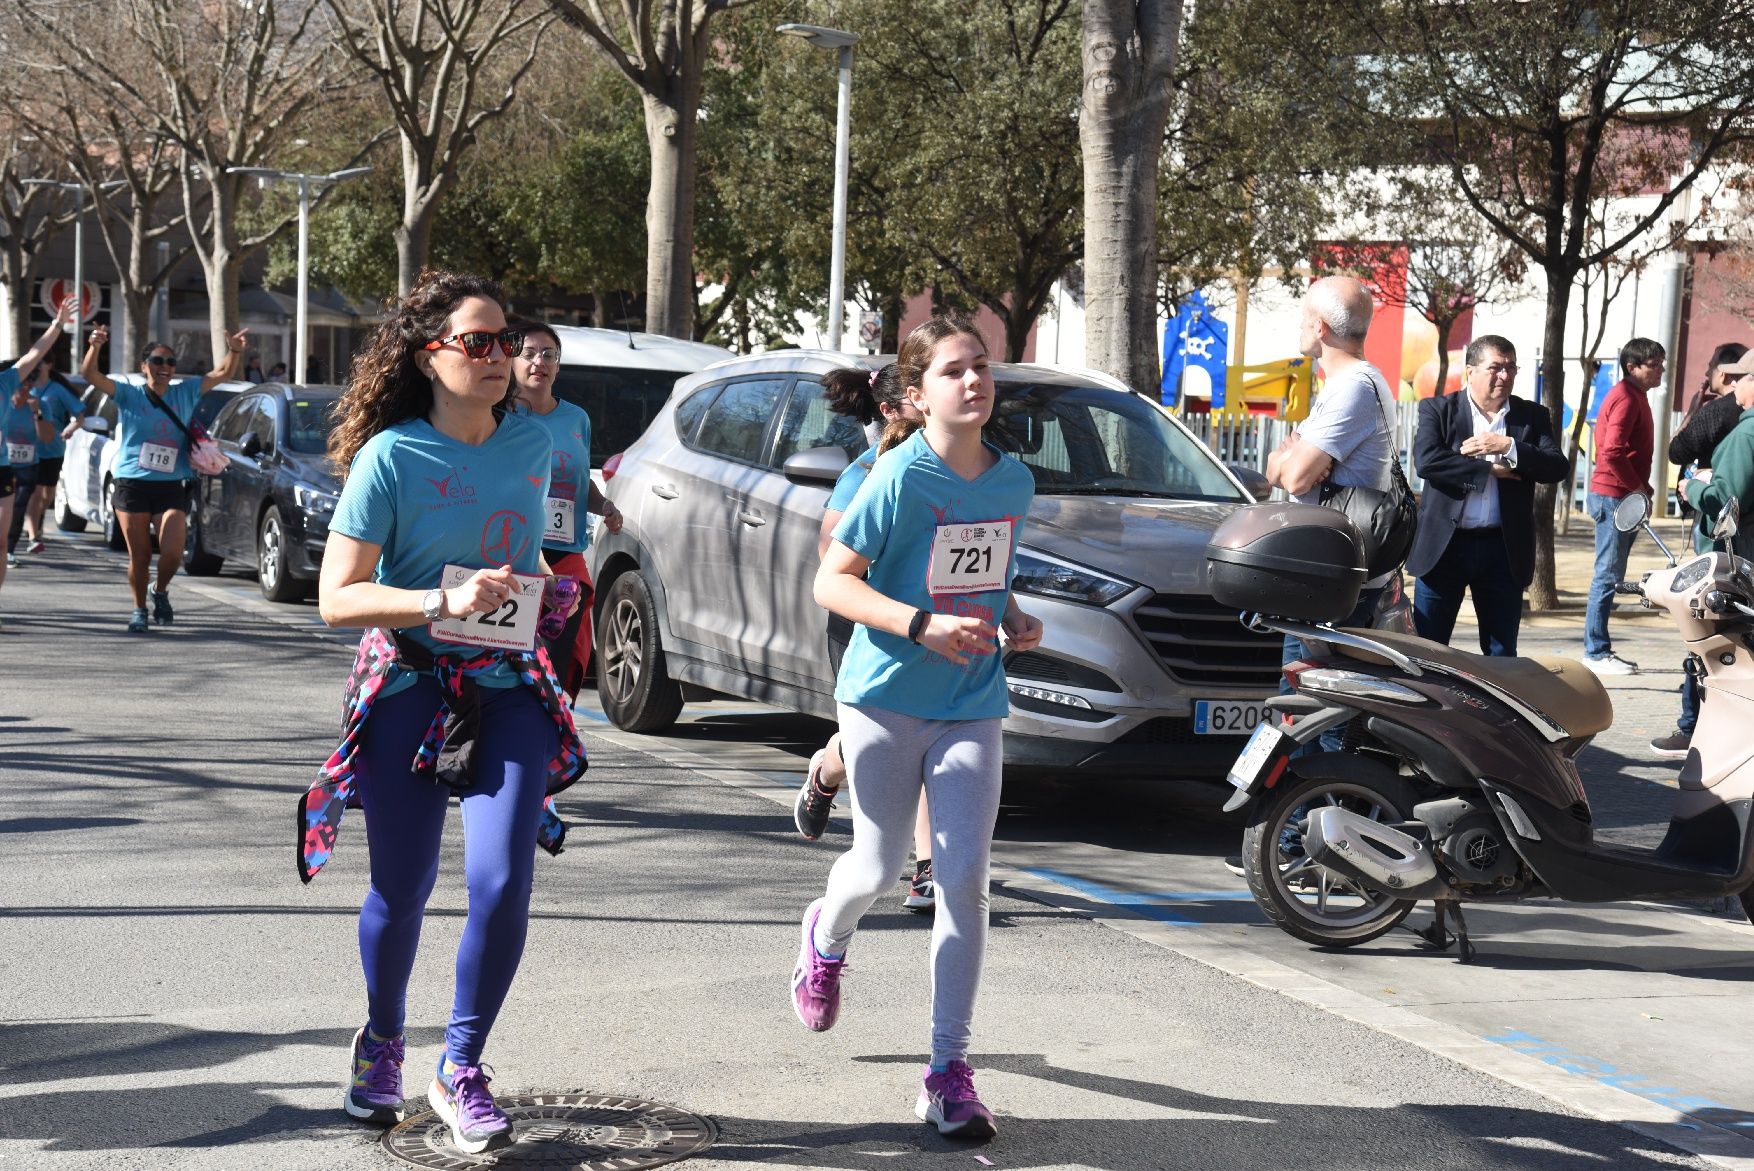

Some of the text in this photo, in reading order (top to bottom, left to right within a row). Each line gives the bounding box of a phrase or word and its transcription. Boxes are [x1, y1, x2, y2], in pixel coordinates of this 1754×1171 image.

[10, 449, 28, 459] 219
[149, 452, 170, 465] 118
[553, 512, 563, 529] 3
[950, 545, 992, 574] 721
[460, 598, 519, 628] 22
[1212, 706, 1273, 730] 6208
